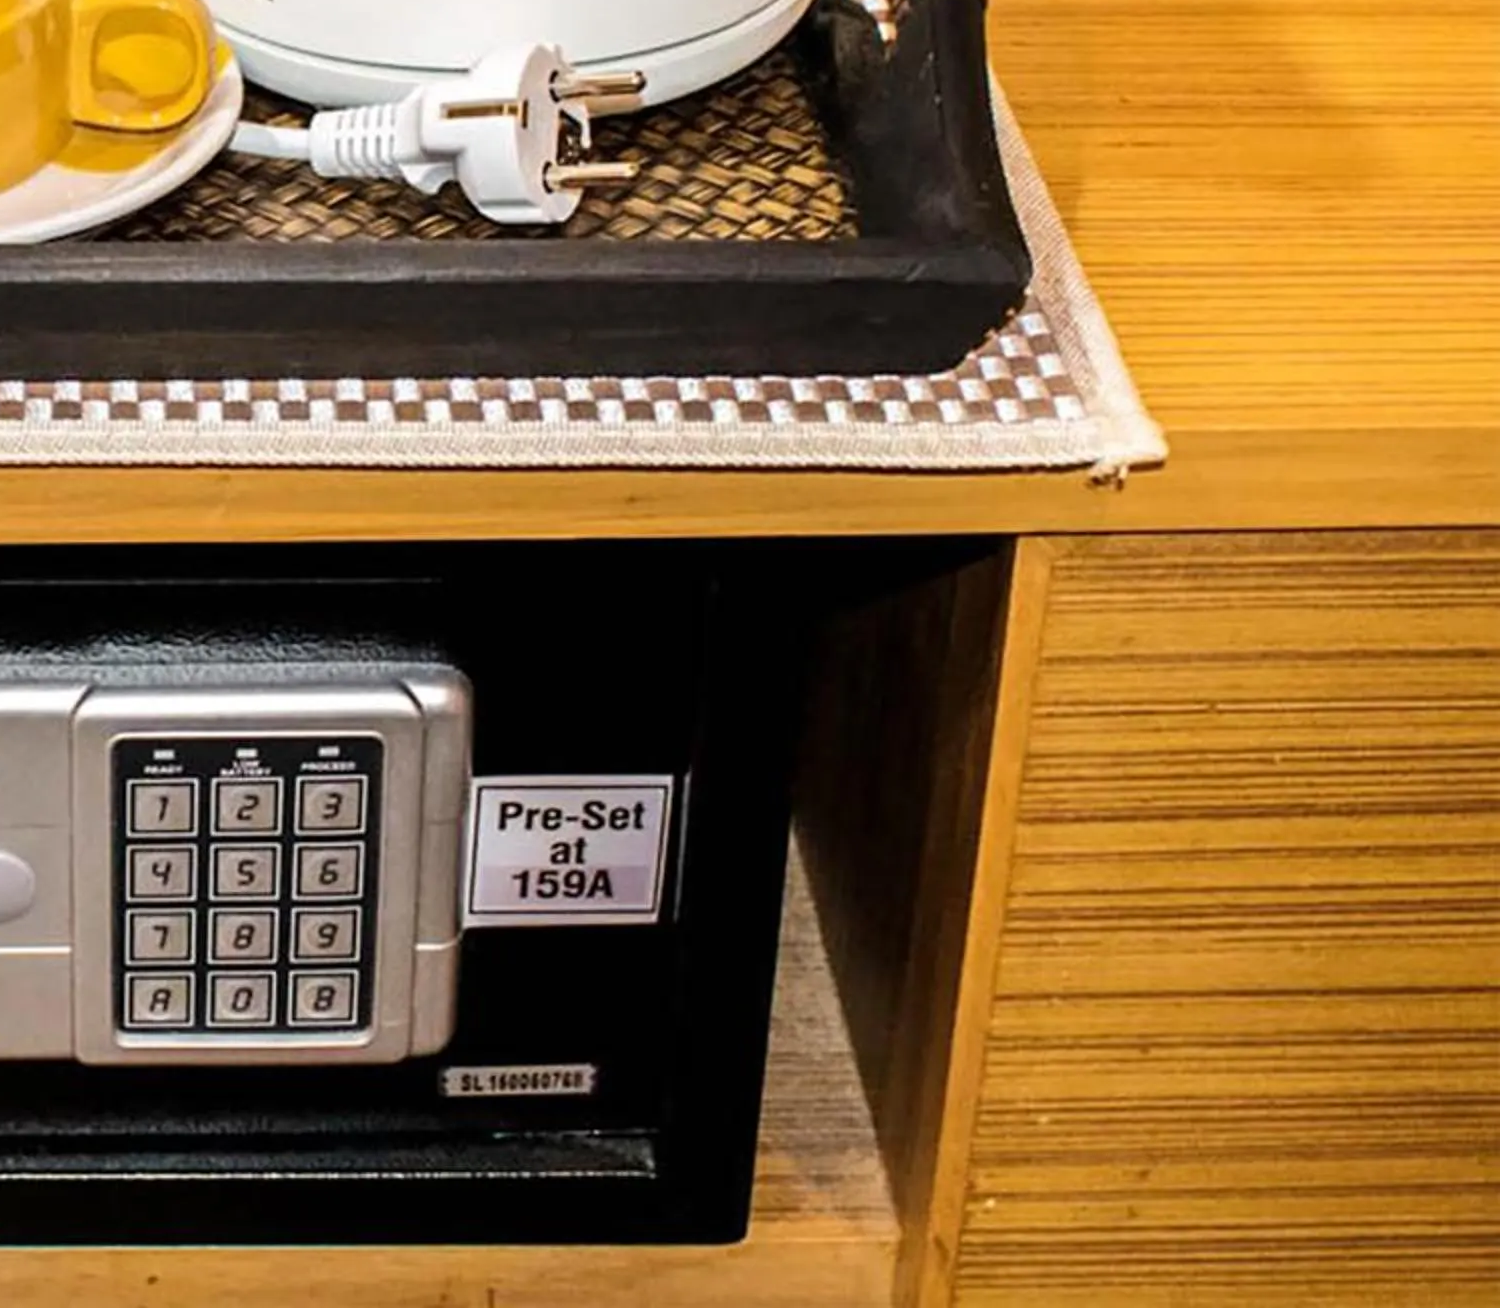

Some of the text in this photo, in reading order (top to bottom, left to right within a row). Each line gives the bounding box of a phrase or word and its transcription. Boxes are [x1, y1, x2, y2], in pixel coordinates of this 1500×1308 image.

[144, 764, 183, 775] READY
[220, 767, 271, 778] BATTERY
[159, 796, 169, 821] 1
[237, 794, 260, 821] 2
[322, 793, 343, 819] 3
[497, 800, 646, 831] Pre-Set
[550, 837, 588, 865] at
[152, 861, 172, 886] 4
[237, 860, 256, 885] 5
[319, 859, 338, 885] 6
[512, 868, 613, 899] 159A
[153, 924, 169, 949] 7
[233, 924, 255, 950] 8
[318, 923, 338, 948] 9
[150, 988, 171, 1012] A
[231, 987, 252, 1013] 0
[461, 1073, 484, 1092] SL
